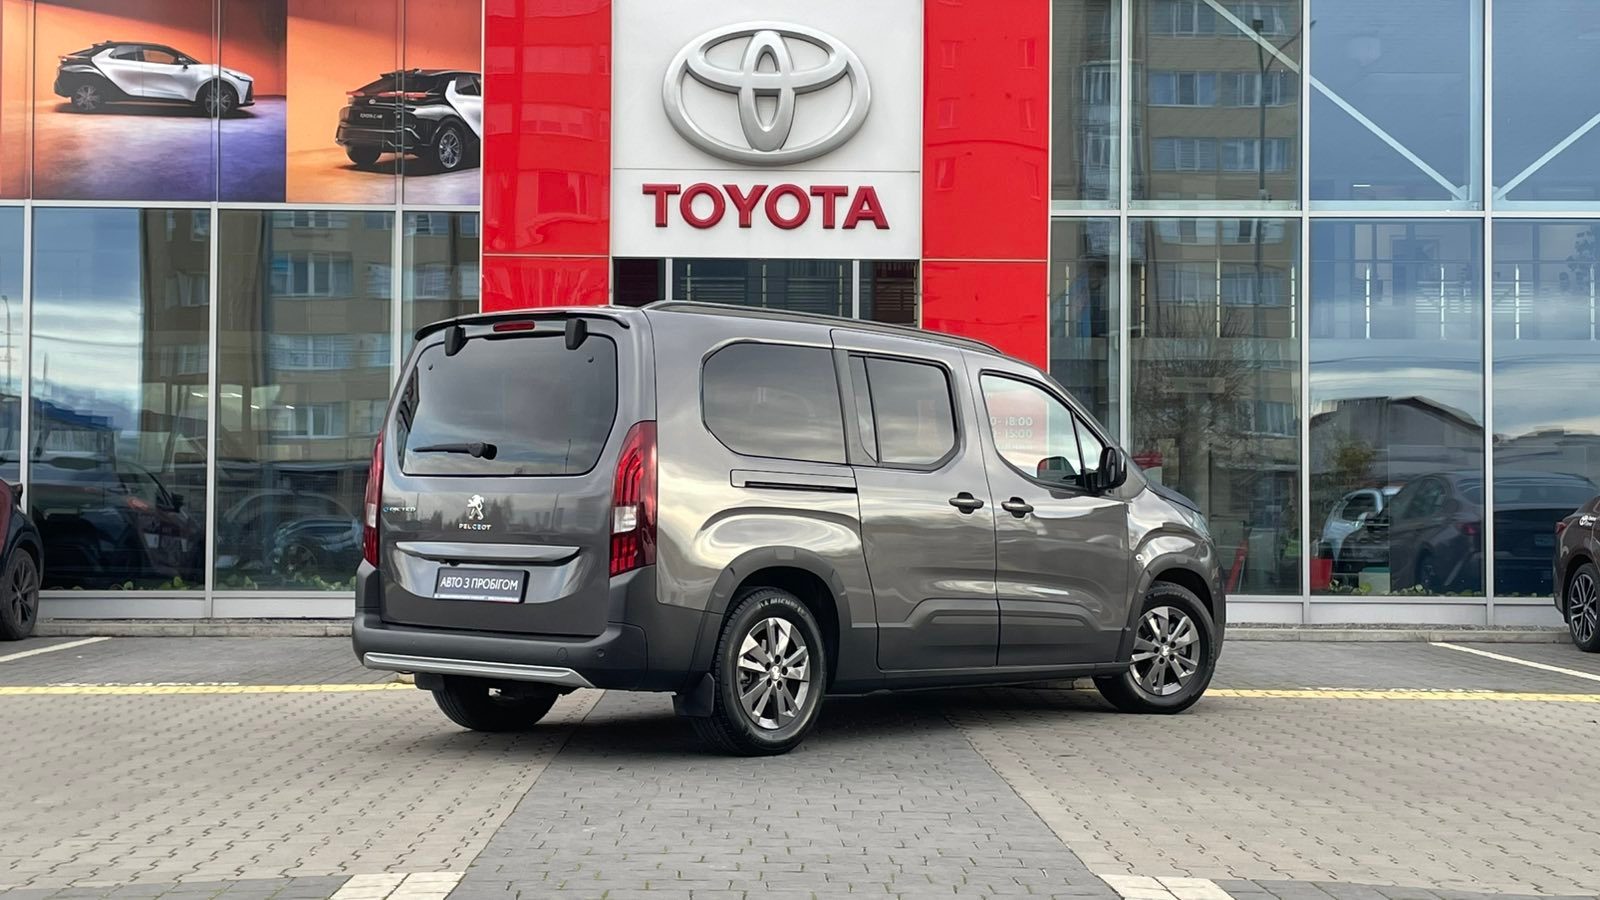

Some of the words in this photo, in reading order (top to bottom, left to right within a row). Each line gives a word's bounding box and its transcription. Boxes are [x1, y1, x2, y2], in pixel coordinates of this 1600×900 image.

[642, 183, 890, 230] TOYOTA
[440, 576, 463, 589] АВТО
[470, 577, 519, 591] ПРОБІГОМ
